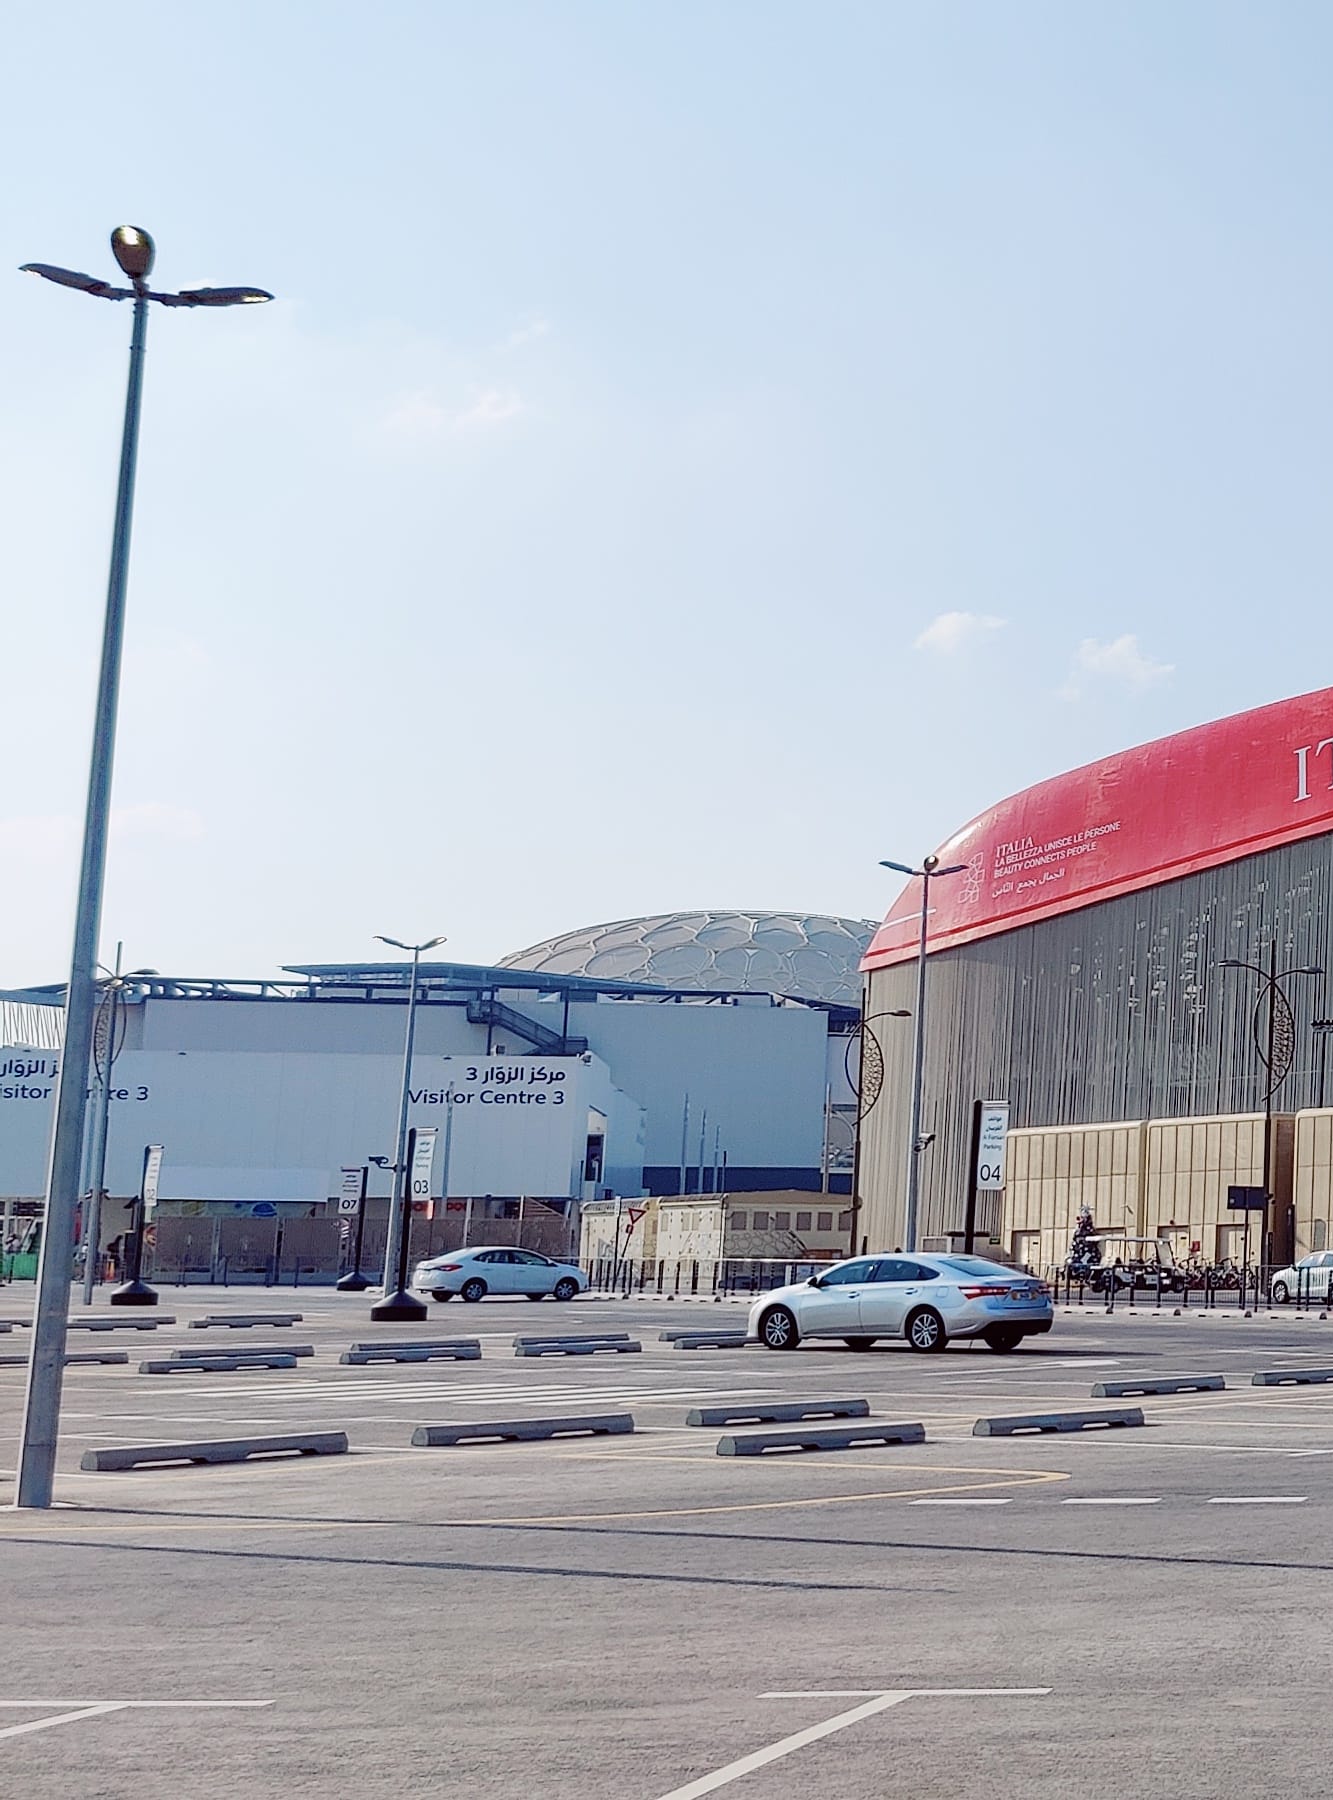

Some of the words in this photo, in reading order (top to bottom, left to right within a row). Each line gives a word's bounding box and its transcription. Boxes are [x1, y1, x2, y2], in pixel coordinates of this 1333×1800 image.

[995, 855, 1006, 868] LA
[1006, 845, 1043, 864] BELLEZZA
[1044, 837, 1073, 851] UNISCE
[1073, 832, 1084, 844] LE
[1084, 821, 1121, 840] PERSONE
[996, 836, 1034, 858] ITALIA
[994, 861, 1023, 879] BEAUTY
[1024, 850, 1066, 870] CONNECTS
[1066, 841, 1097, 858] PEOPLE
[466, 1067, 477, 1081] 3
[528, 1066, 566, 1084] مركز
[0, 1083, 52, 1099] isitor
[136, 1086, 148, 1100] 3
[408, 1089, 475, 1104] Visitor
[480, 1090, 547, 1104] Centre
[552, 1091, 564, 1105] 3
[980, 1164, 1001, 1181] 04
[414, 1180, 428, 1194] 03
[341, 1199, 357, 1209] 07
